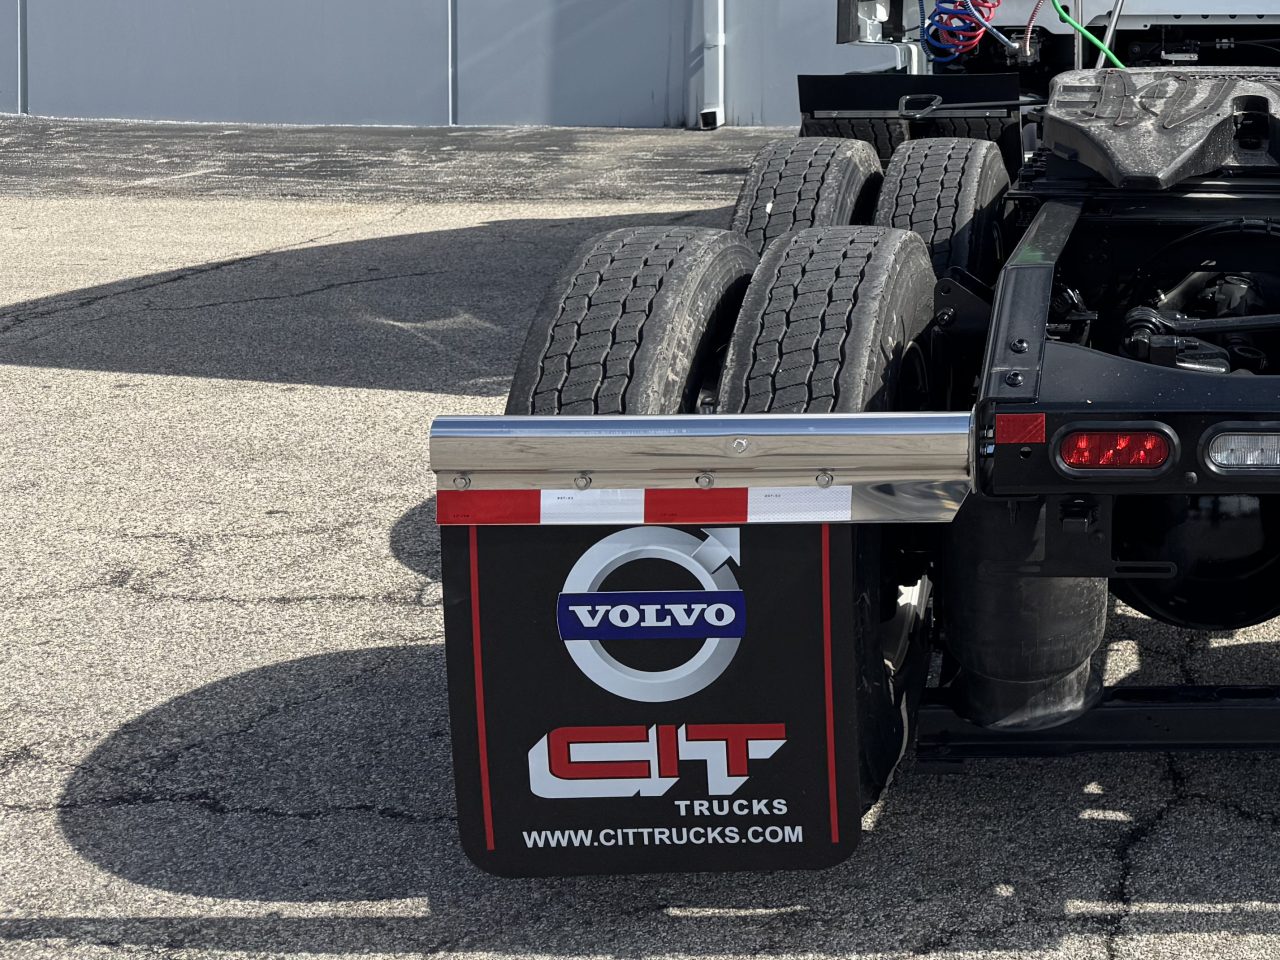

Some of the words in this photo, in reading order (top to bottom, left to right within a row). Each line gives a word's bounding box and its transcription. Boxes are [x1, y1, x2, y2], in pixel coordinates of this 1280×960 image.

[568, 603, 736, 628] VOLVO
[528, 723, 788, 799] CIT
[675, 798, 788, 816] TRUCKS
[522, 825, 804, 849] WWW.CITTRUCKS.COM
